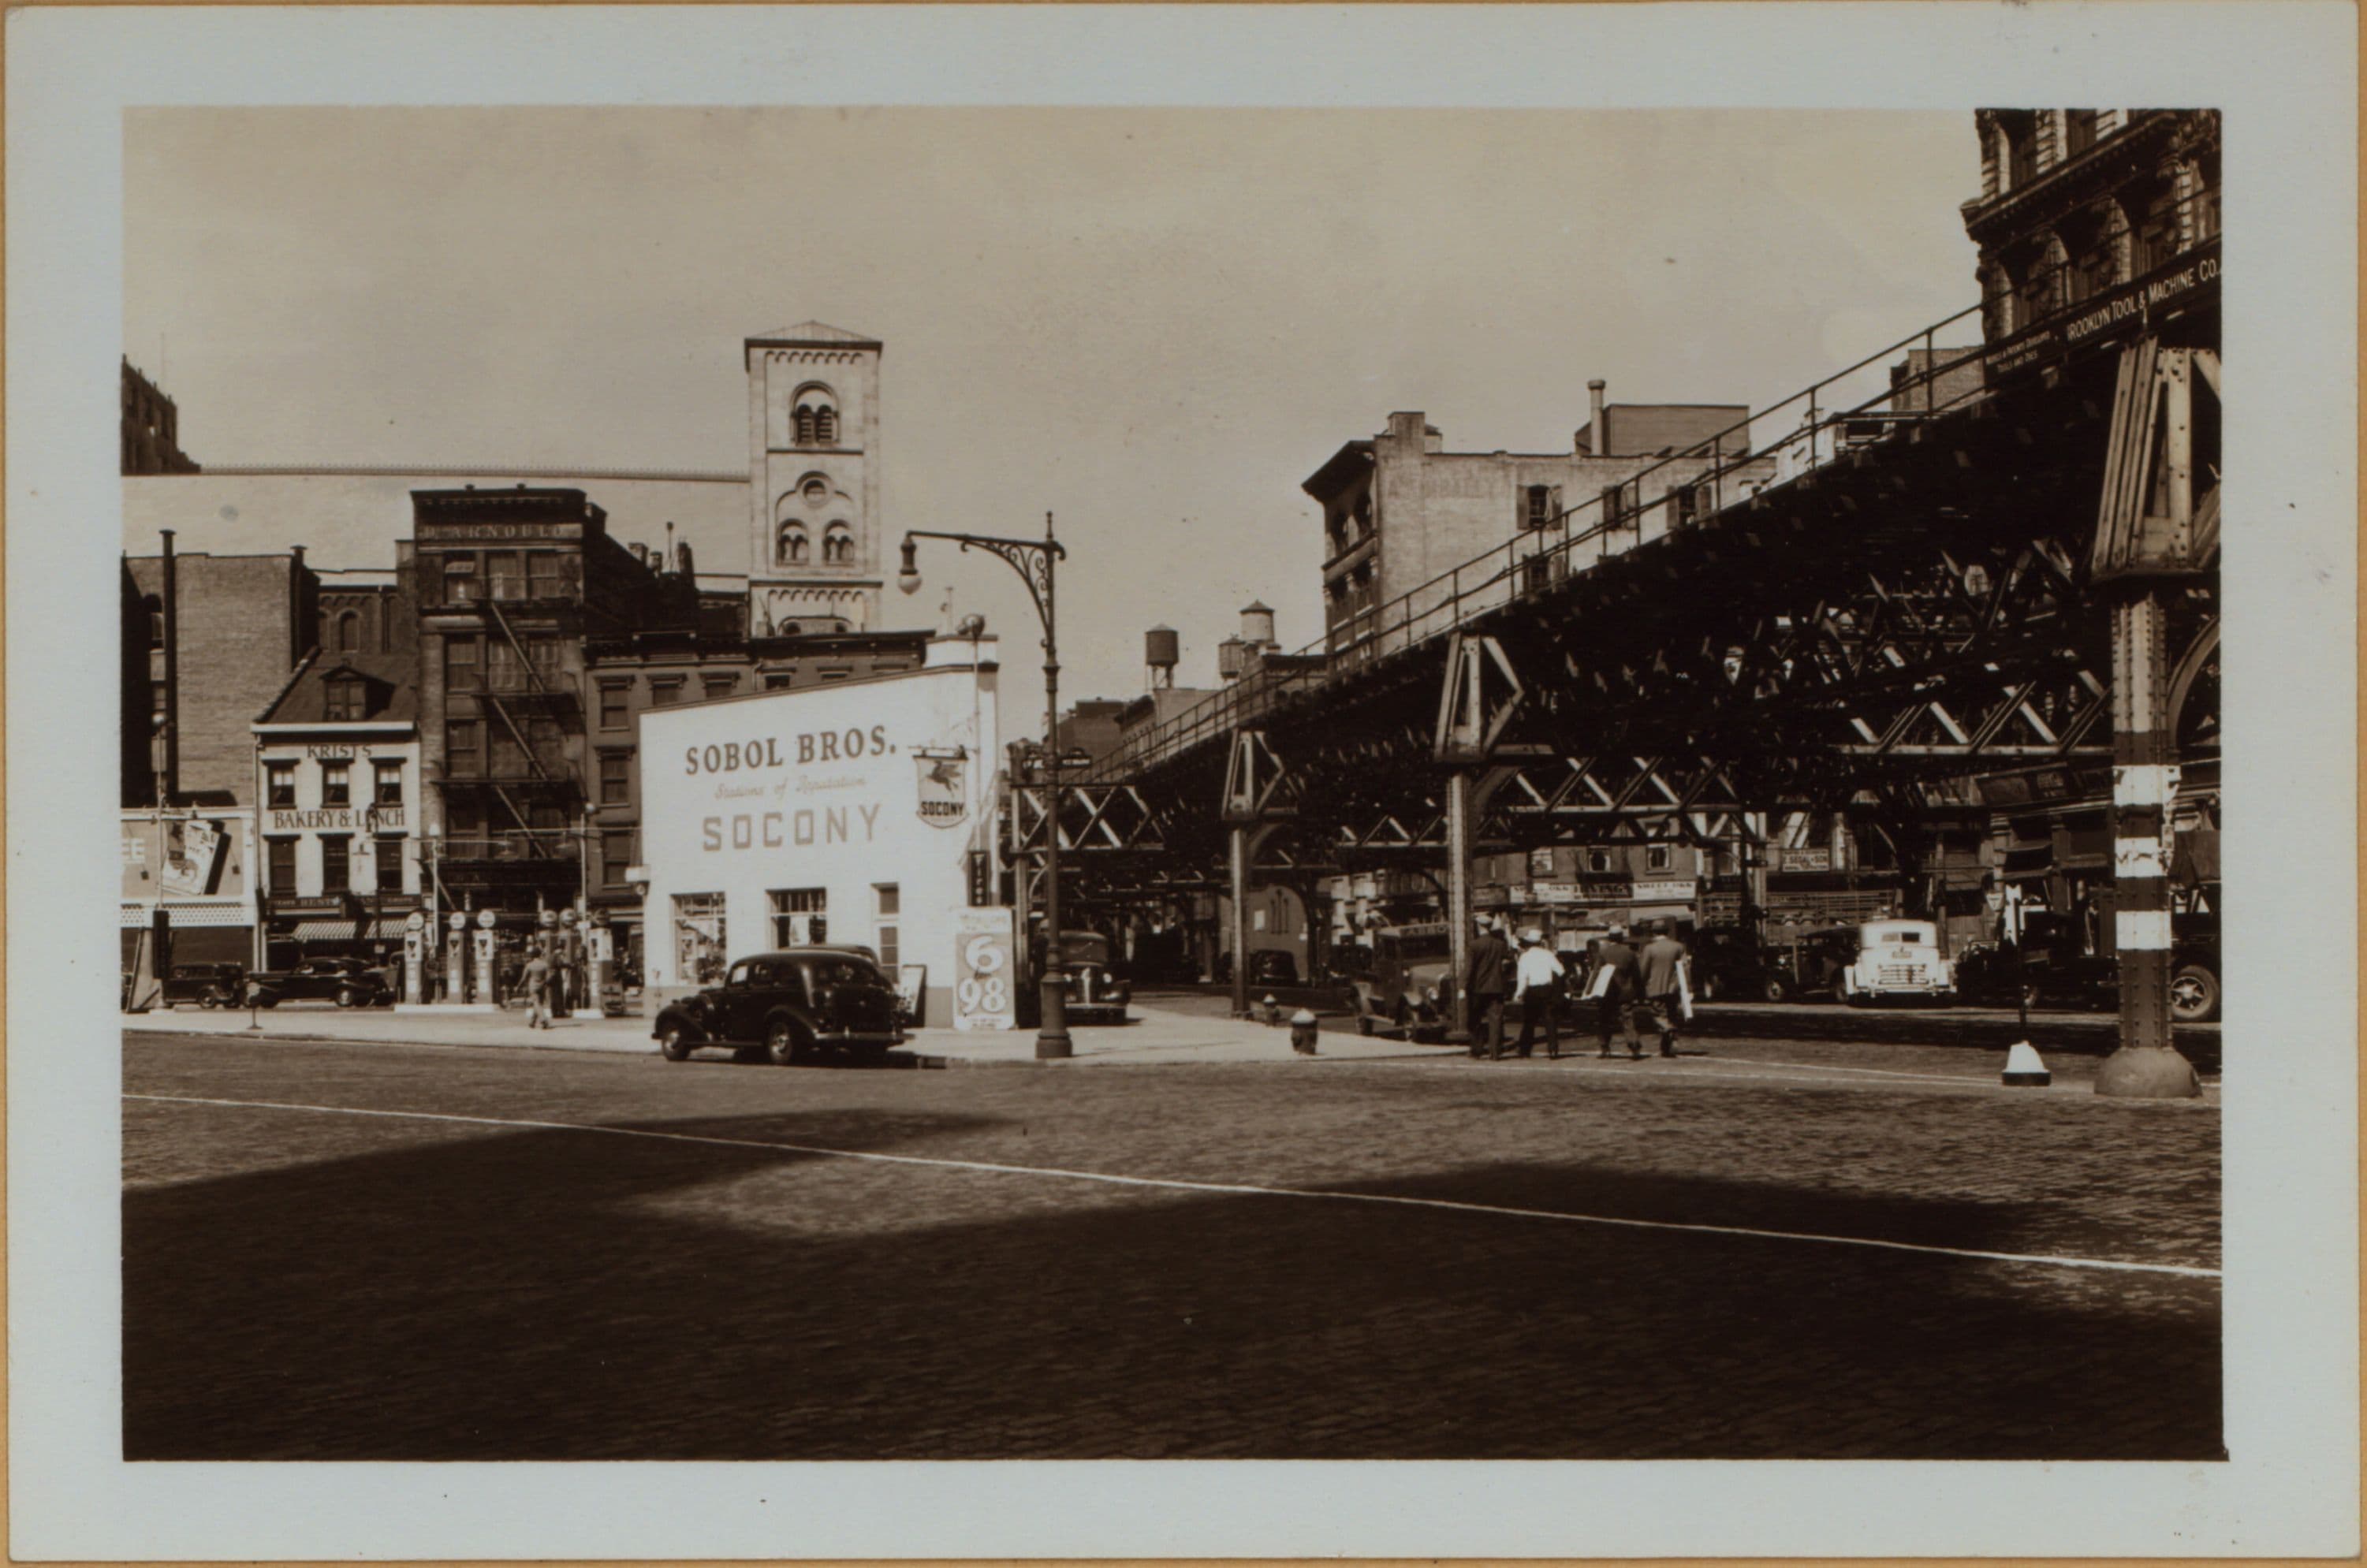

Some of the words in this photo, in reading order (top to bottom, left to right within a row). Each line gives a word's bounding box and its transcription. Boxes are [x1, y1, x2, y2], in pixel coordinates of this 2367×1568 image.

[2111, 296, 2138, 322] TOOL
[2138, 290, 2146, 311] &
[2149, 267, 2196, 305] MACHINE
[686, 737, 784, 776] SOBOL
[796, 724, 896, 765] BROS.
[714, 782, 765, 800] Stations
[775, 776, 788, 801] of
[796, 773, 866, 796] Reputation
[274, 810, 335, 829] BAKERY
[339, 810, 352, 829] &
[921, 801, 964, 817] SOCONY
[703, 803, 882, 852] SOCONY
[966, 936, 1003, 973] 6
[959, 978, 1006, 1013] 98
